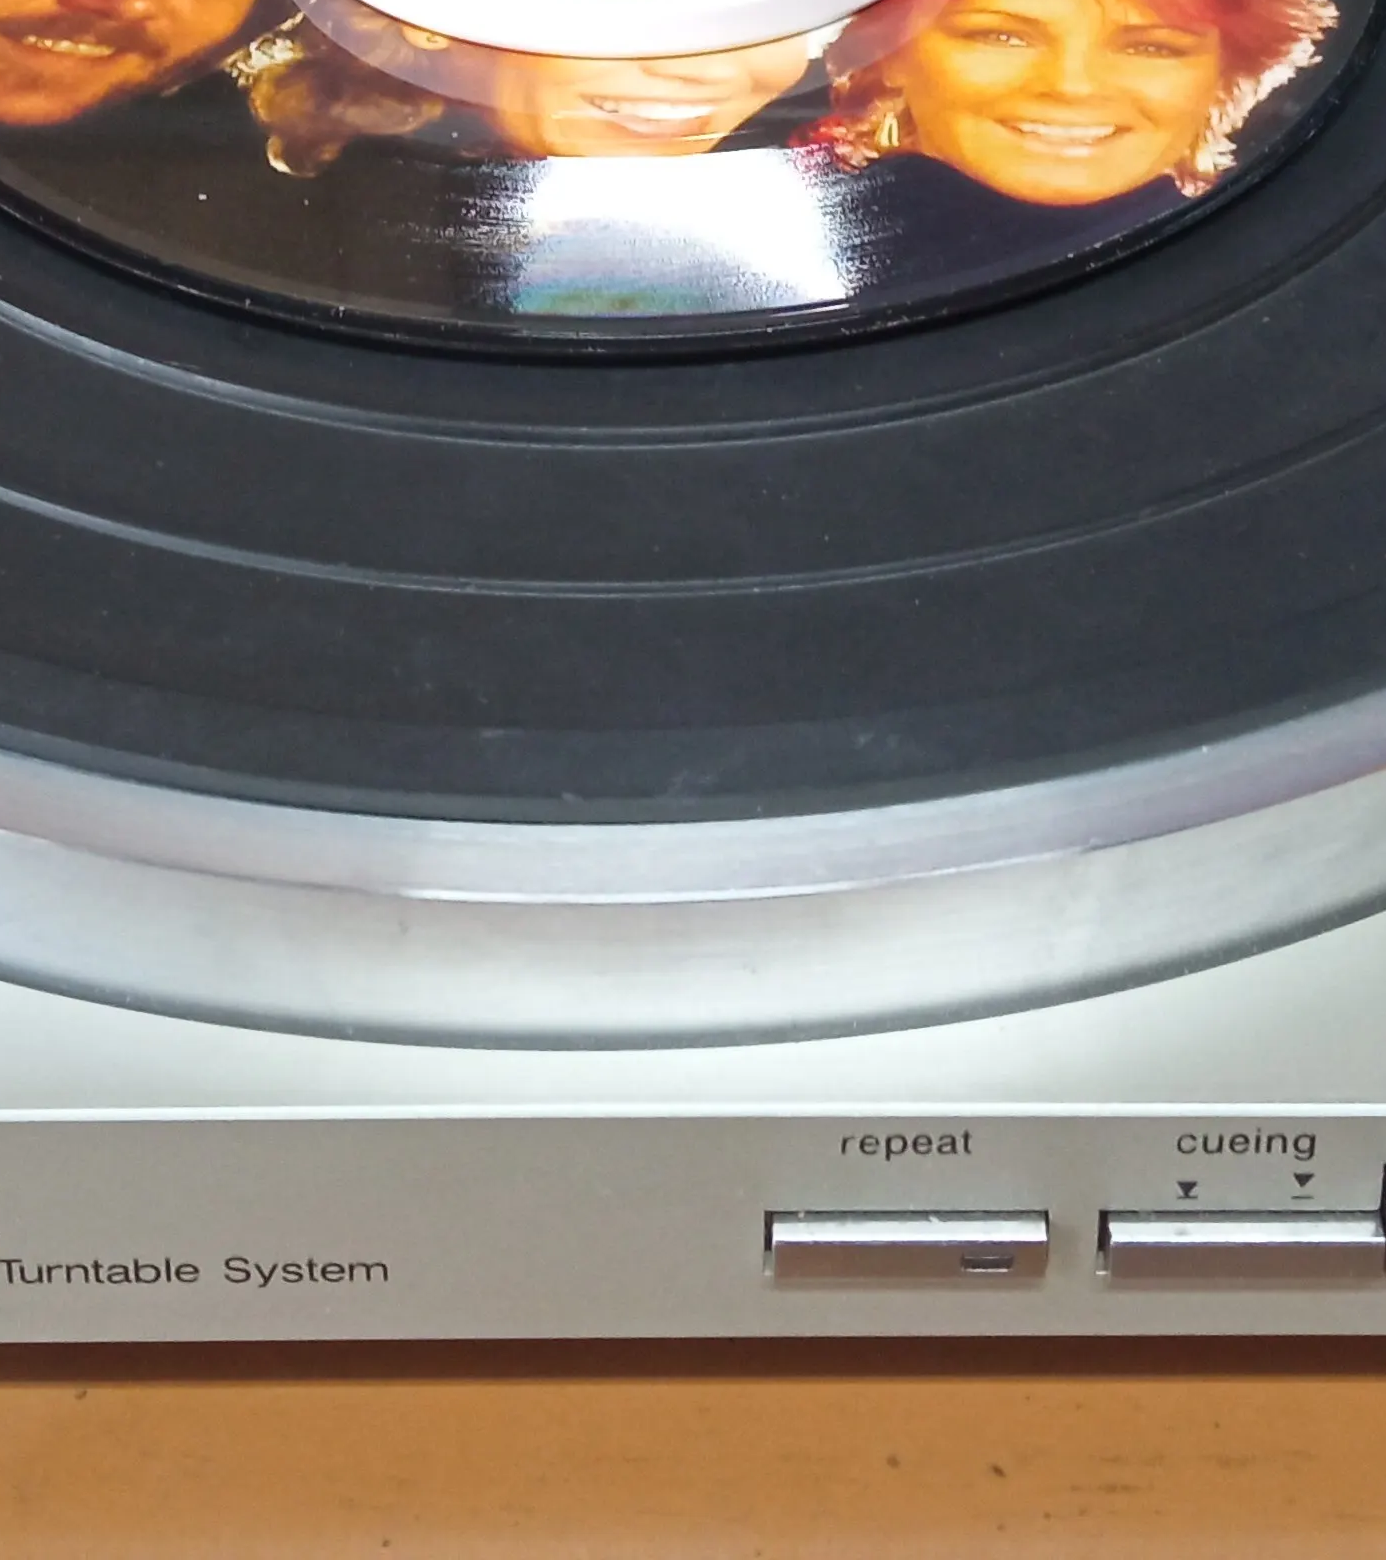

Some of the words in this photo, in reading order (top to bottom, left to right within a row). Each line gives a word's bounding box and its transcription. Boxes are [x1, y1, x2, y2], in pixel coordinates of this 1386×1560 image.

[840, 1129, 973, 1161] repeat
[1177, 1128, 1317, 1161] cueing
[223, 1256, 390, 1289] System
